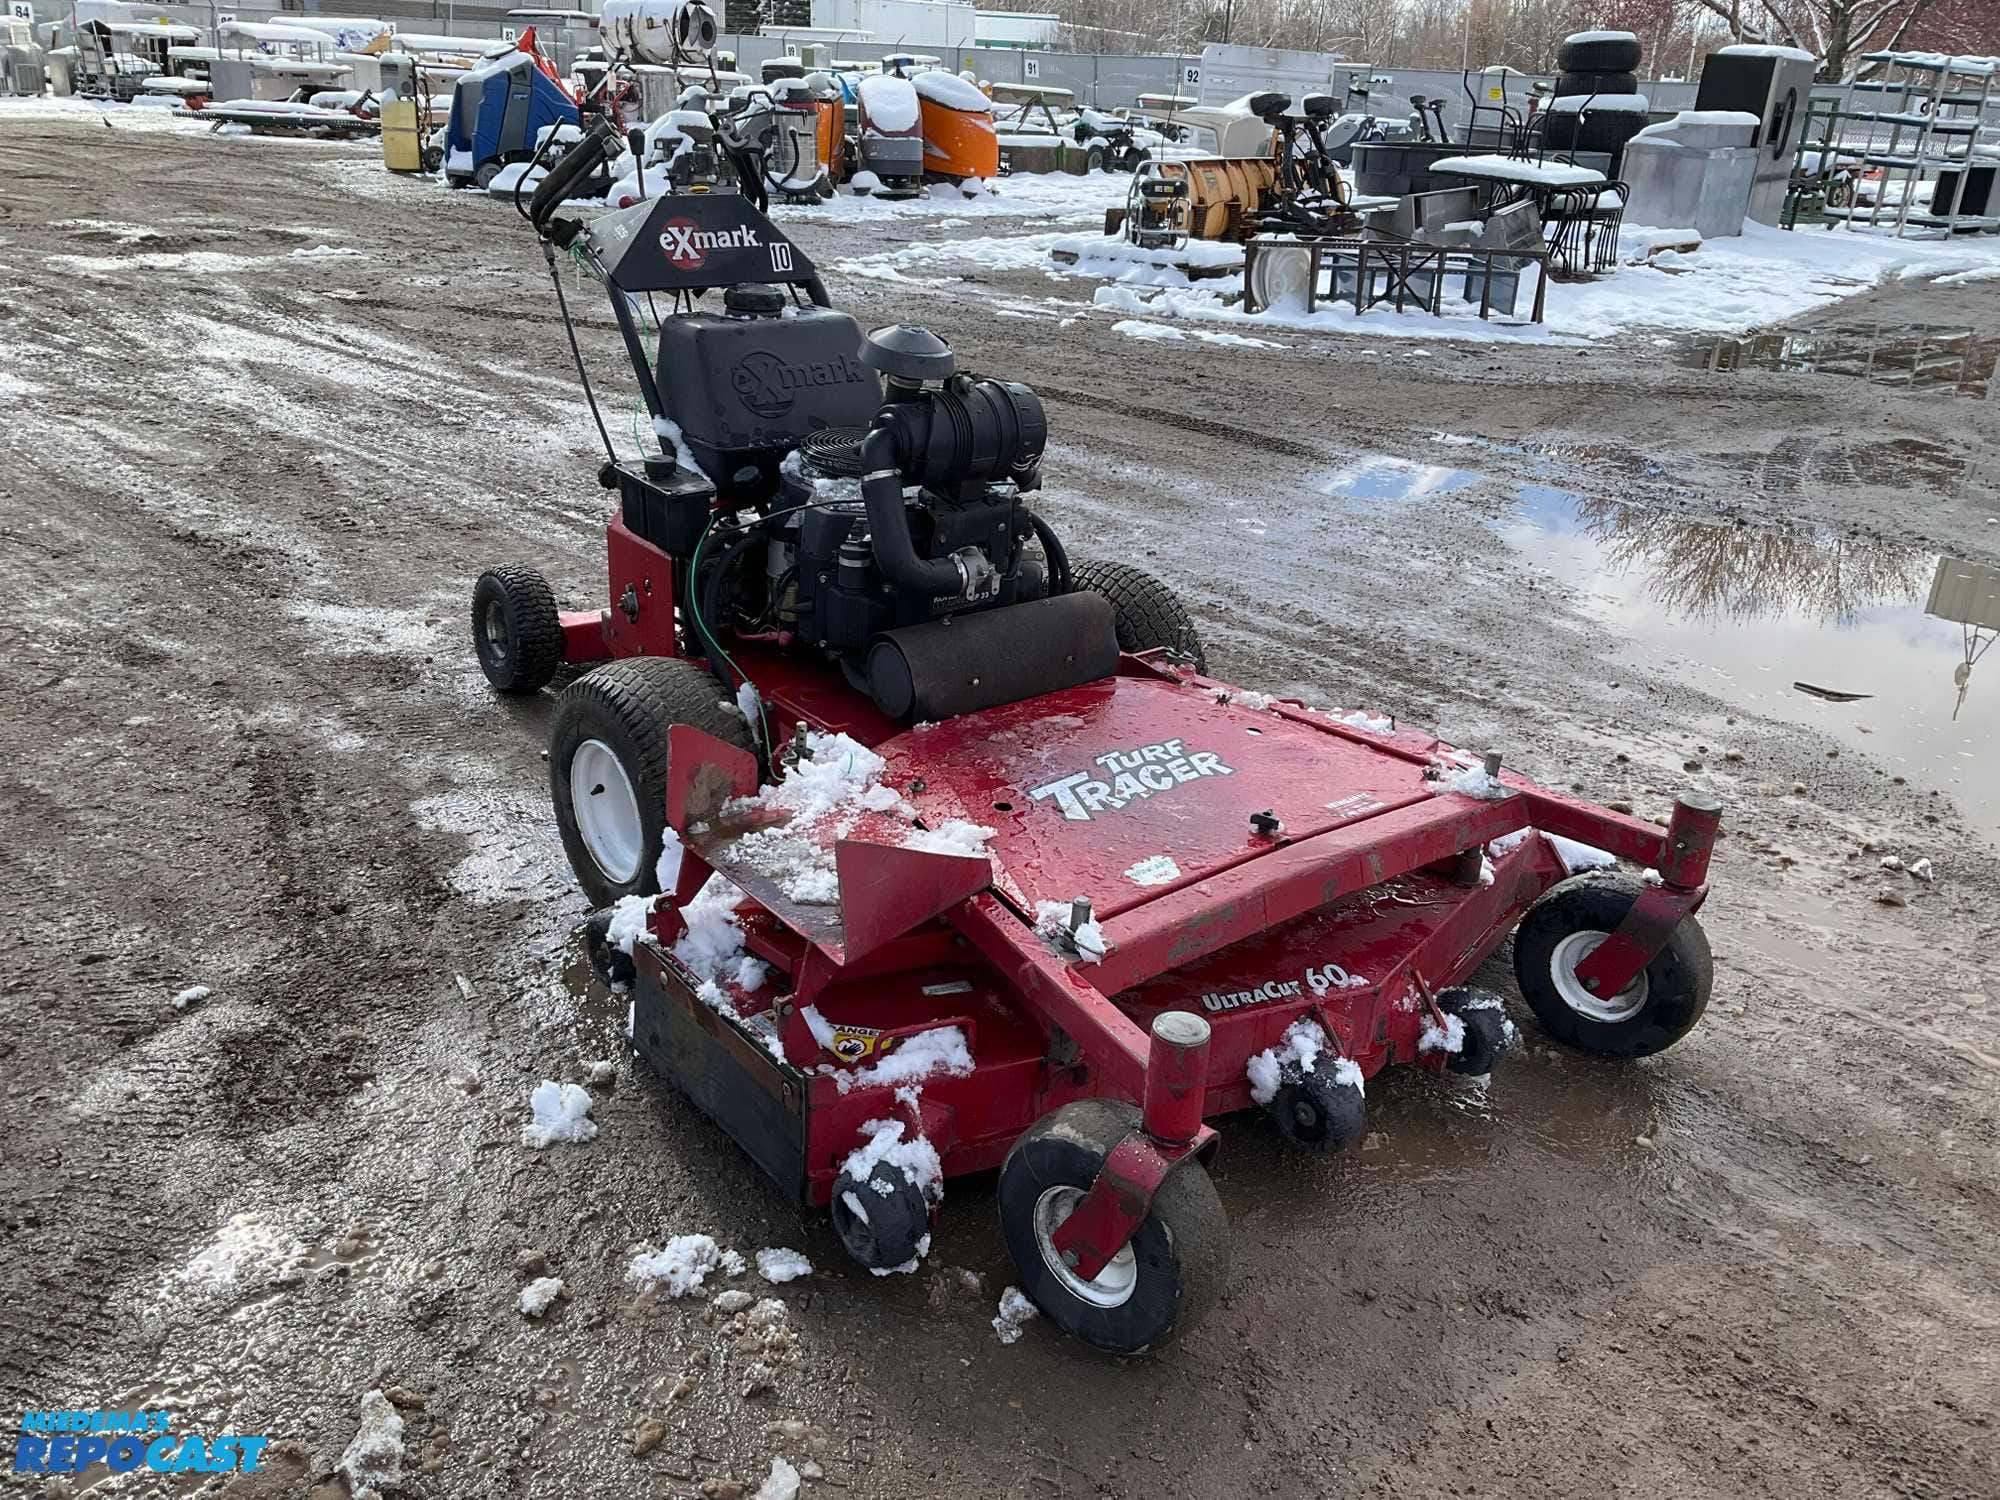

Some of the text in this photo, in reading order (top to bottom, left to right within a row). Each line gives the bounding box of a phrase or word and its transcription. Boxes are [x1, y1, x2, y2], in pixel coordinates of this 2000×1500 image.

[15, 5, 30, 19] 84
[1027, 62, 1037, 75] 91
[1187, 69, 1199, 83] 92
[771, 243, 792, 271] 10
[1096, 738, 1184, 774] TURF
[1029, 751, 1235, 821] TRACER
[1305, 963, 1351, 990] 60
[830, 1023, 881, 1038] ANGE
